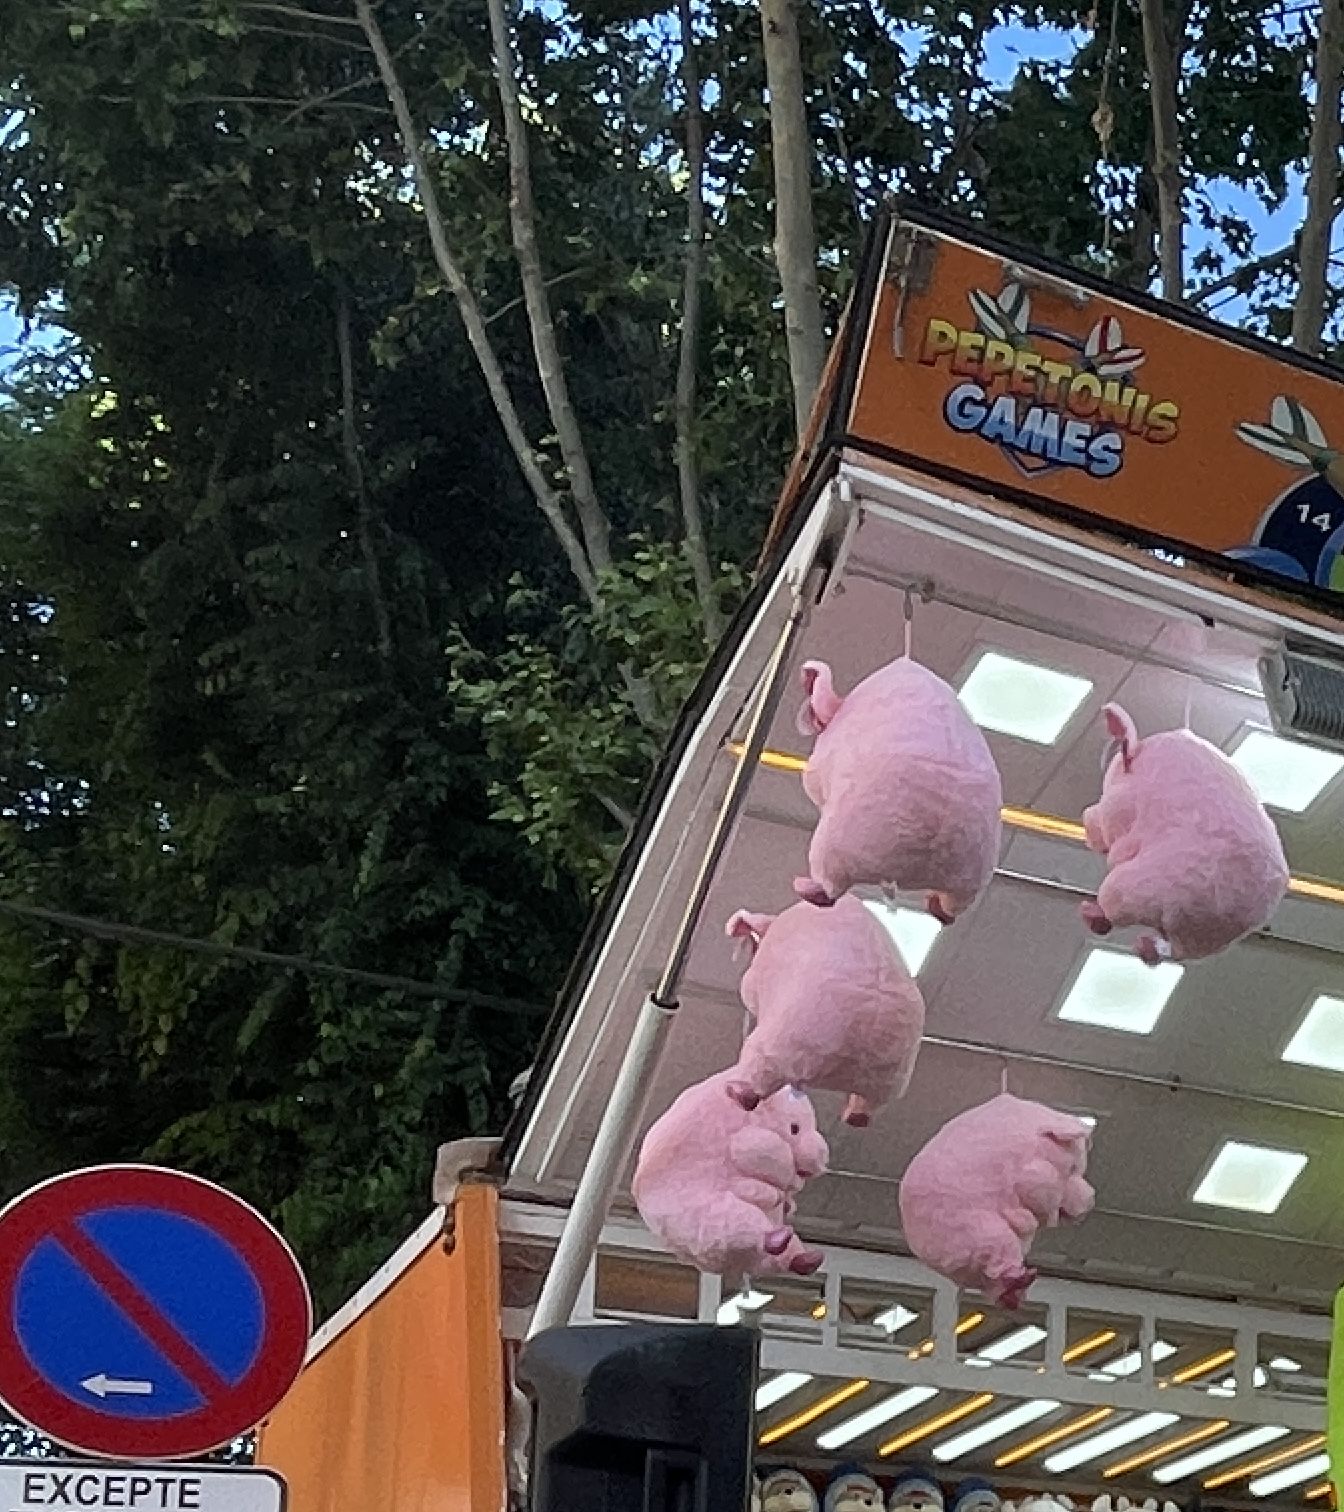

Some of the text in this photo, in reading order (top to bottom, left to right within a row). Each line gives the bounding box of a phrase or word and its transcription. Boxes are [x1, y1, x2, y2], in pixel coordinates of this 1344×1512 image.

[919, 318, 1181, 443] PEPETONIS
[944, 381, 1124, 478] GAMES
[1296, 503, 1332, 533] 14
[23, 1473, 202, 1509] EXCEPTE
